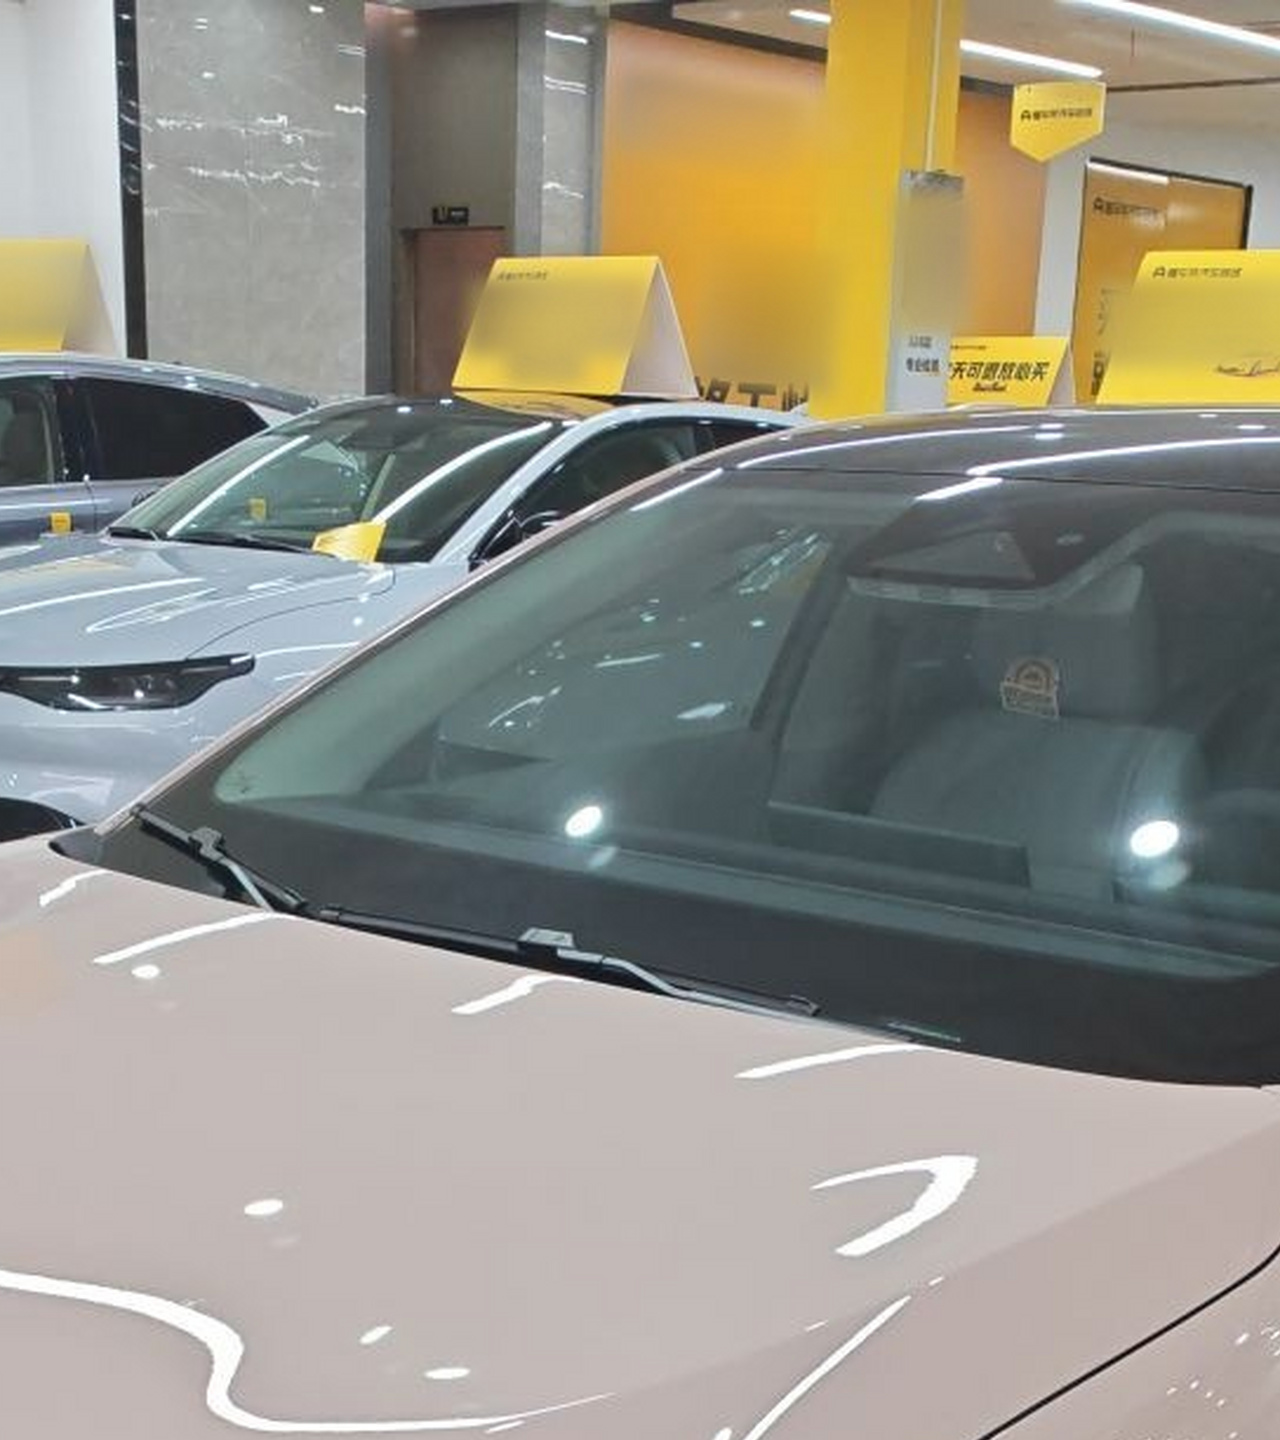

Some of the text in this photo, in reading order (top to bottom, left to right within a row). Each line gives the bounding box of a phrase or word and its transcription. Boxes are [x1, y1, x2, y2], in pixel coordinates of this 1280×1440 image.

[949, 360, 1050, 381] 天可退放心买
